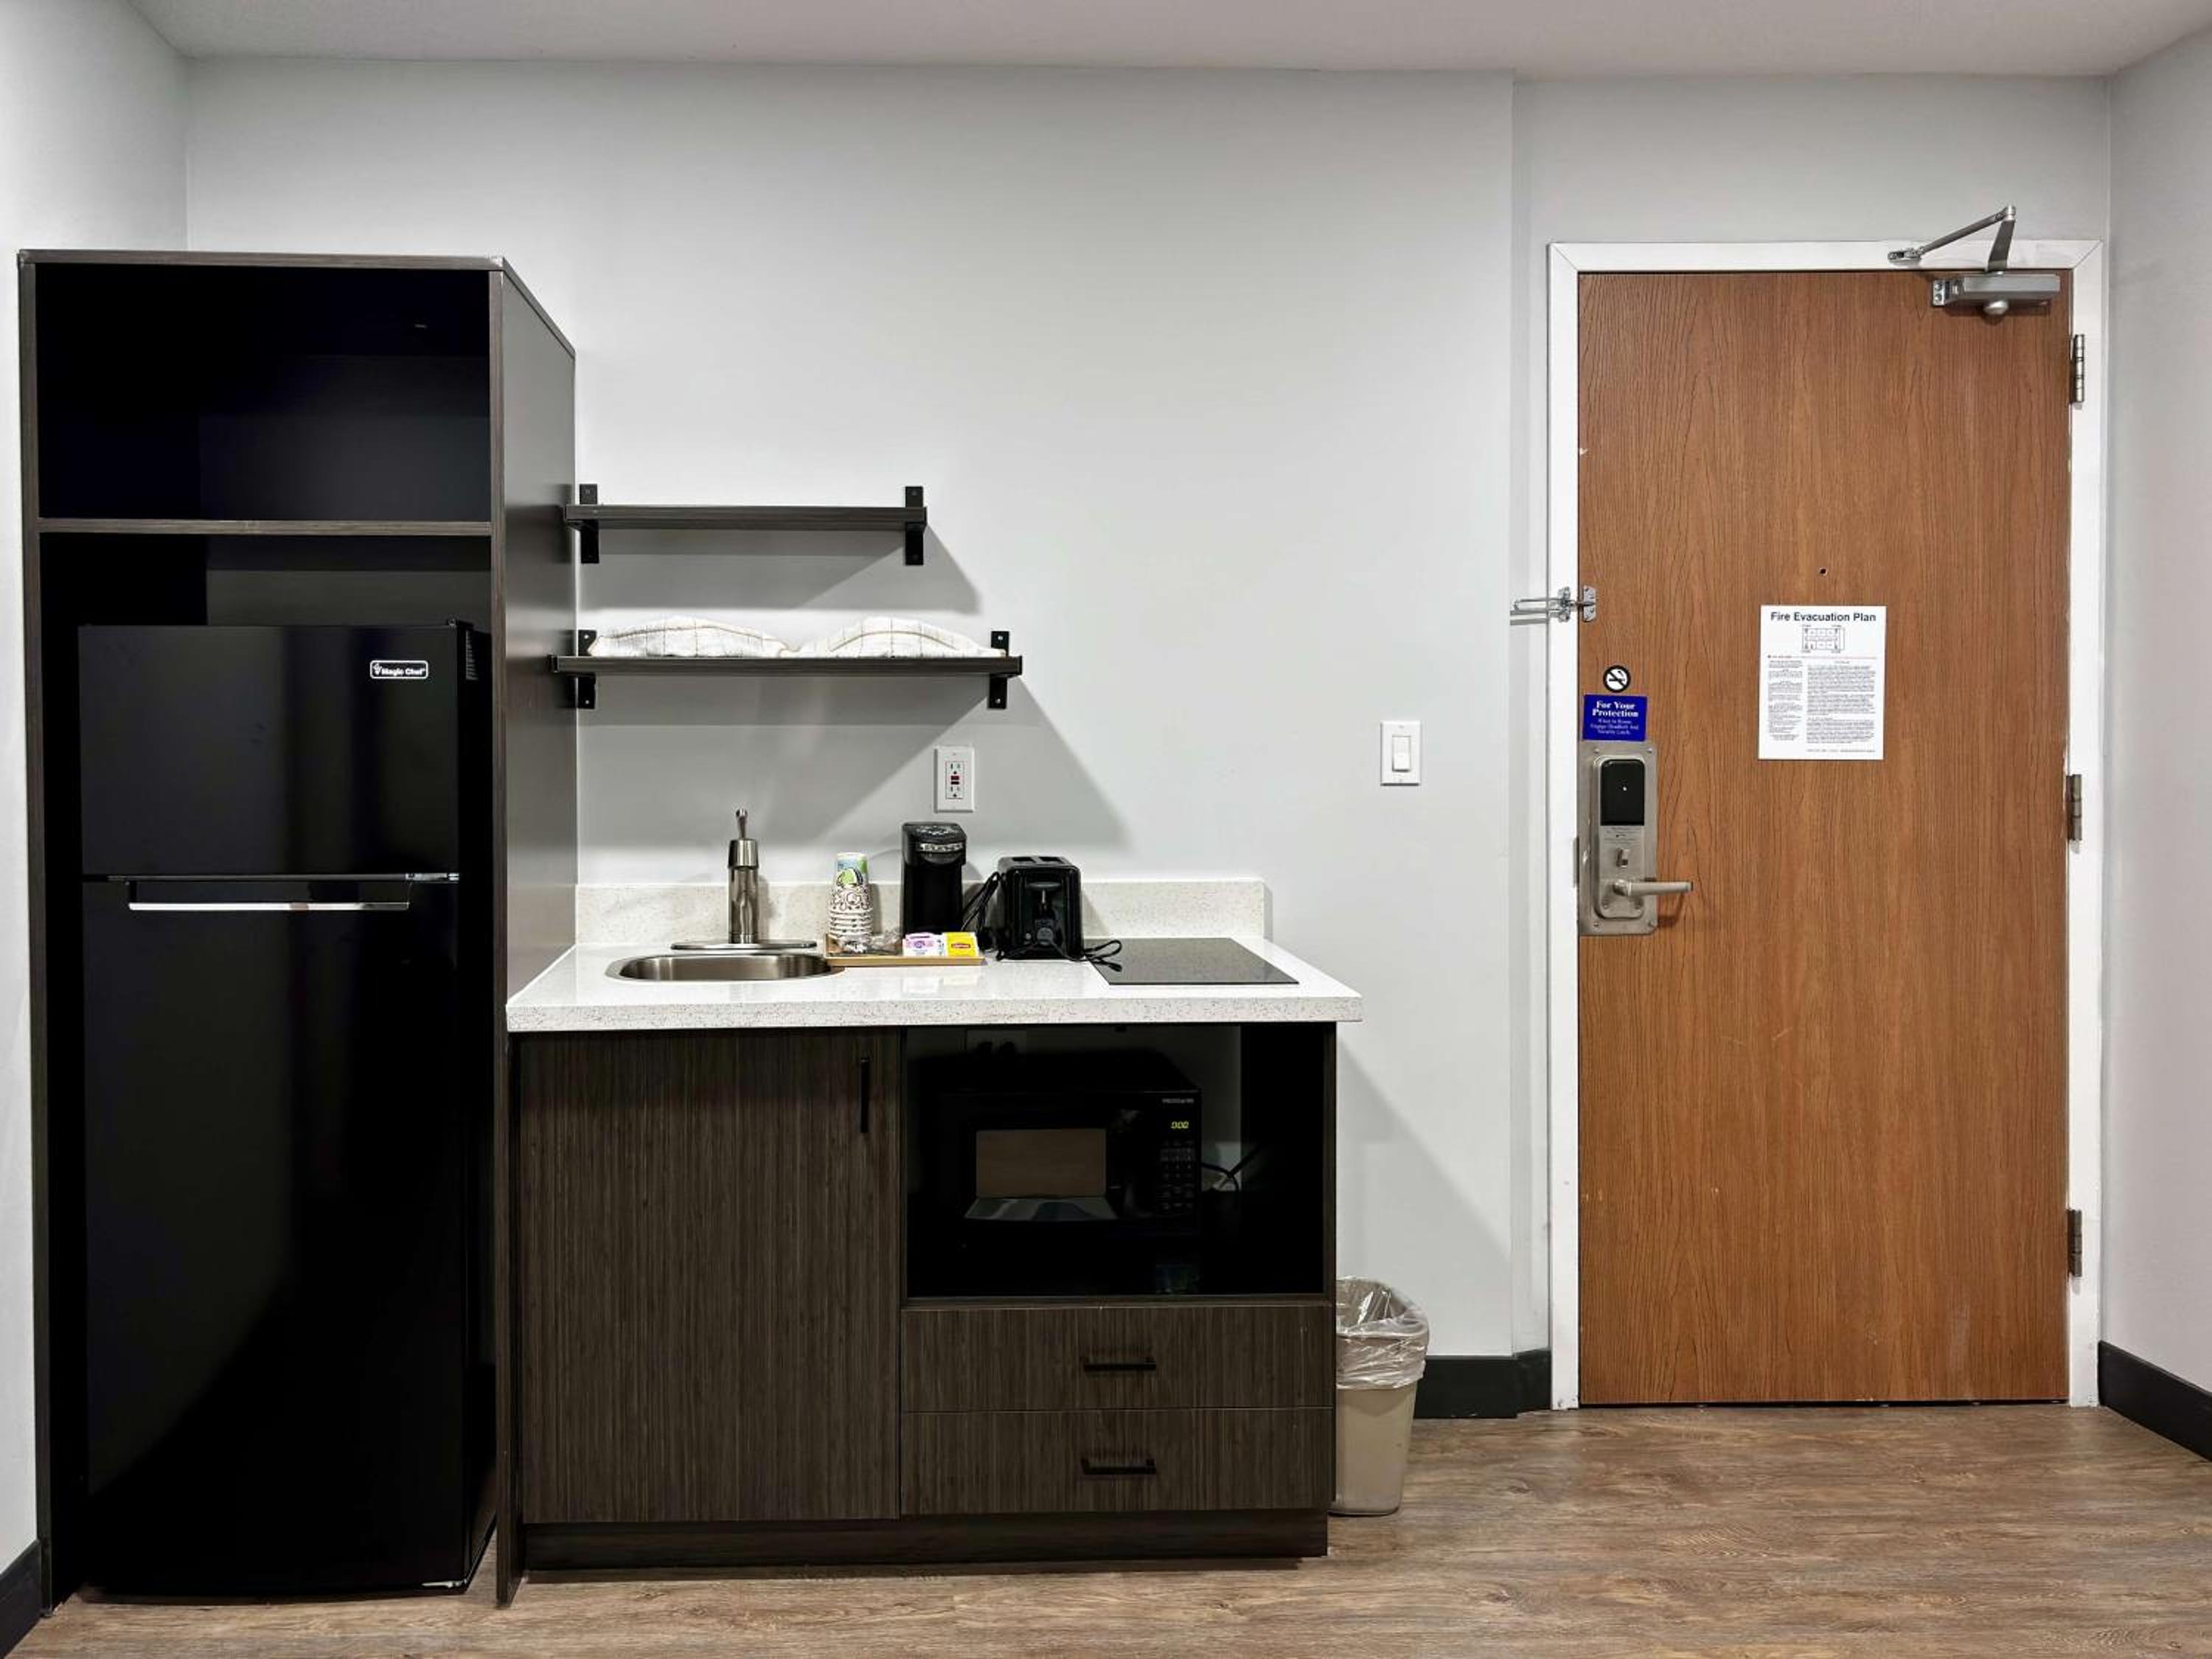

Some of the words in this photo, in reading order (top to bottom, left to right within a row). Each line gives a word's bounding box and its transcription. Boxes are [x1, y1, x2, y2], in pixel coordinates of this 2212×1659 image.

[1771, 612, 1791, 622] Fire
[1794, 612, 1850, 622] Evacuation
[1854, 613, 1877, 622] Plan
[381, 667, 404, 676] Magic
[405, 667, 424, 675] Chef
[1596, 700, 1611, 709] For
[1614, 701, 1635, 709] Your
[1593, 709, 1639, 717] Protection
